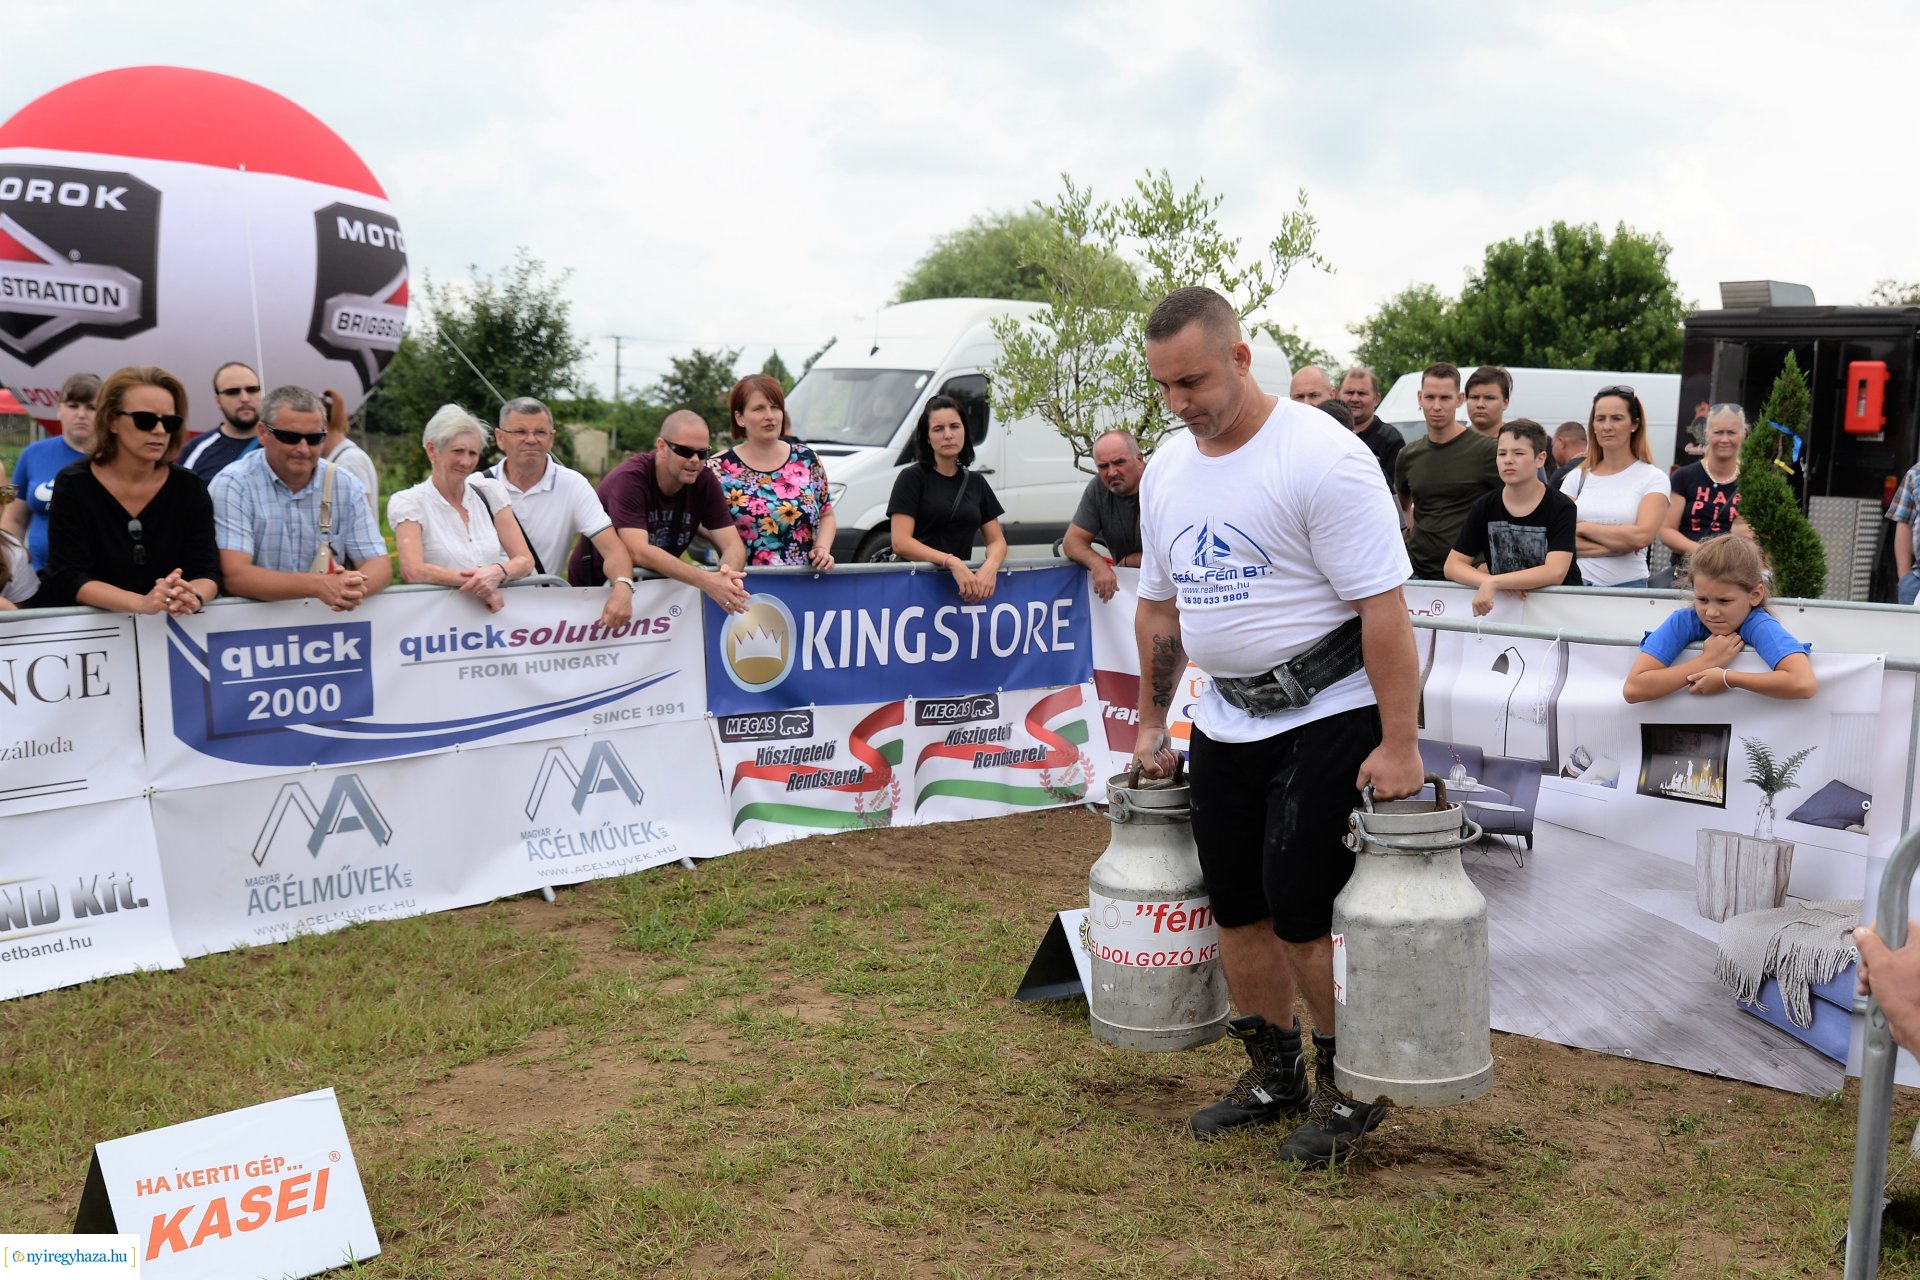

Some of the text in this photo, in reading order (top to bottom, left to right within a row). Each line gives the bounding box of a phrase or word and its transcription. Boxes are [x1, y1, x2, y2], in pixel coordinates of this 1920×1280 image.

[1203, 596, 1220, 604] 433
[1223, 592, 1249, 602] 9809
[801, 598, 1075, 671] KINGSTORE
[221, 631, 361, 678] quick
[459, 653, 620, 680] FROM HUNGARY
[247, 683, 341, 720] 2000
[592, 702, 685, 725] SINCE 1991
[922, 702, 971, 719] MEGAS
[726, 717, 776, 735] MEGAS
[755, 740, 837, 766] Hőszigetelő
[786, 766, 867, 792] Rendszerek
[521, 828, 551, 840] MAGYAR
[526, 821, 662, 862] ACÉLMŰVEK
[245, 873, 281, 888] MAGYAR
[247, 863, 403, 916] ACÉLMŰVEK
[1199, 942, 1220, 962] KF
[136, 1176, 171, 1197] HA
[176, 1164, 240, 1190] KERTI
[145, 1167, 330, 1261] KASEI
